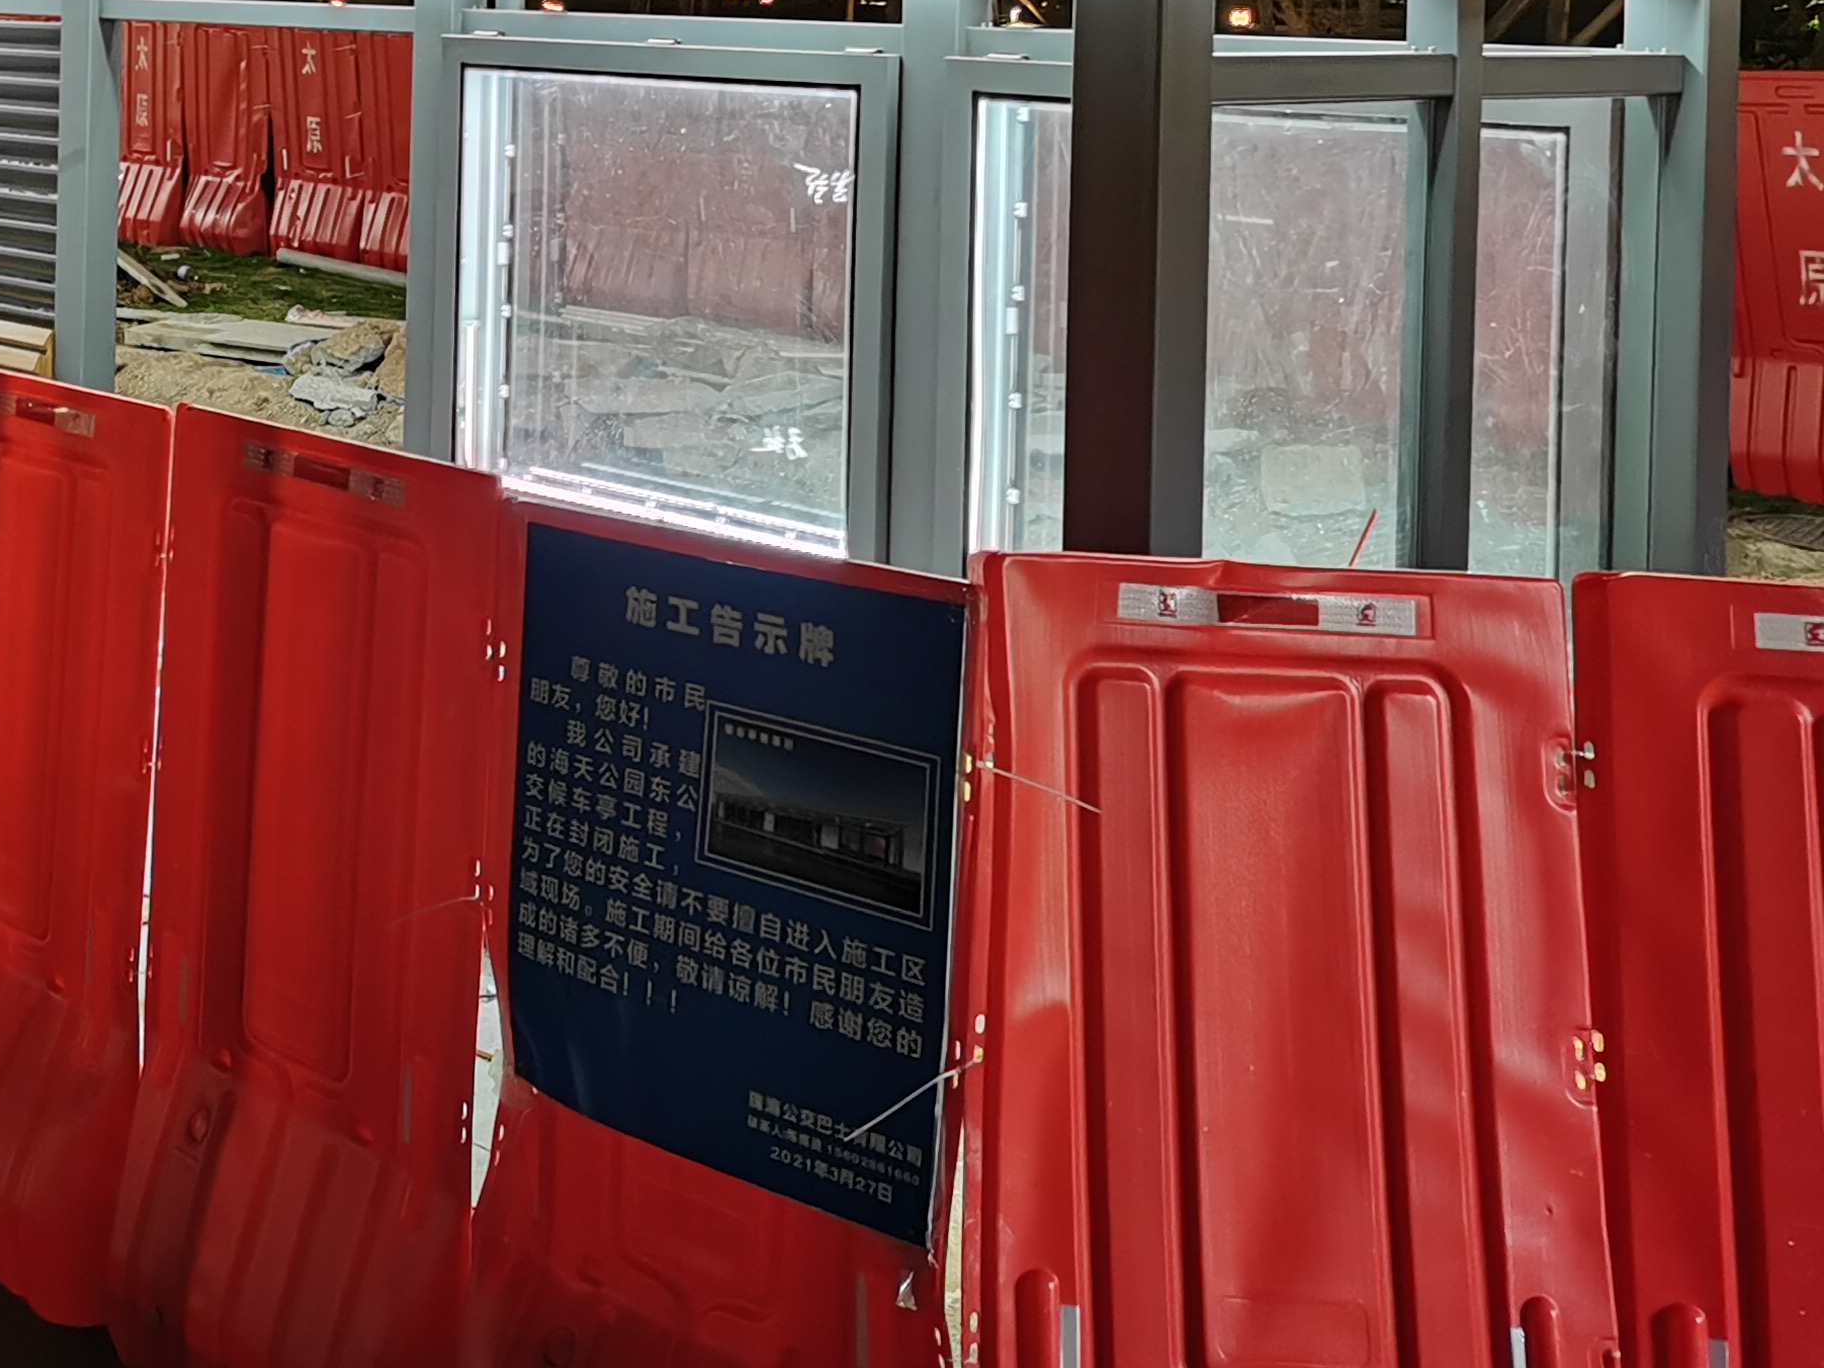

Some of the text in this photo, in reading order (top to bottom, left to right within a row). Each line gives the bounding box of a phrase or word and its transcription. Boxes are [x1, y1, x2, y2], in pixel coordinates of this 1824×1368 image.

[626, 586, 834, 668] 施工告示牌
[570, 655, 706, 712] 尊敬的市民
[527, 740, 698, 812] 的海天公园东公
[566, 720, 701, 778] 我公司承建
[521, 835, 926, 987] 为了您的安全请不要擅自进入施工区
[770, 1146, 894, 1204] 2021年3月27日
